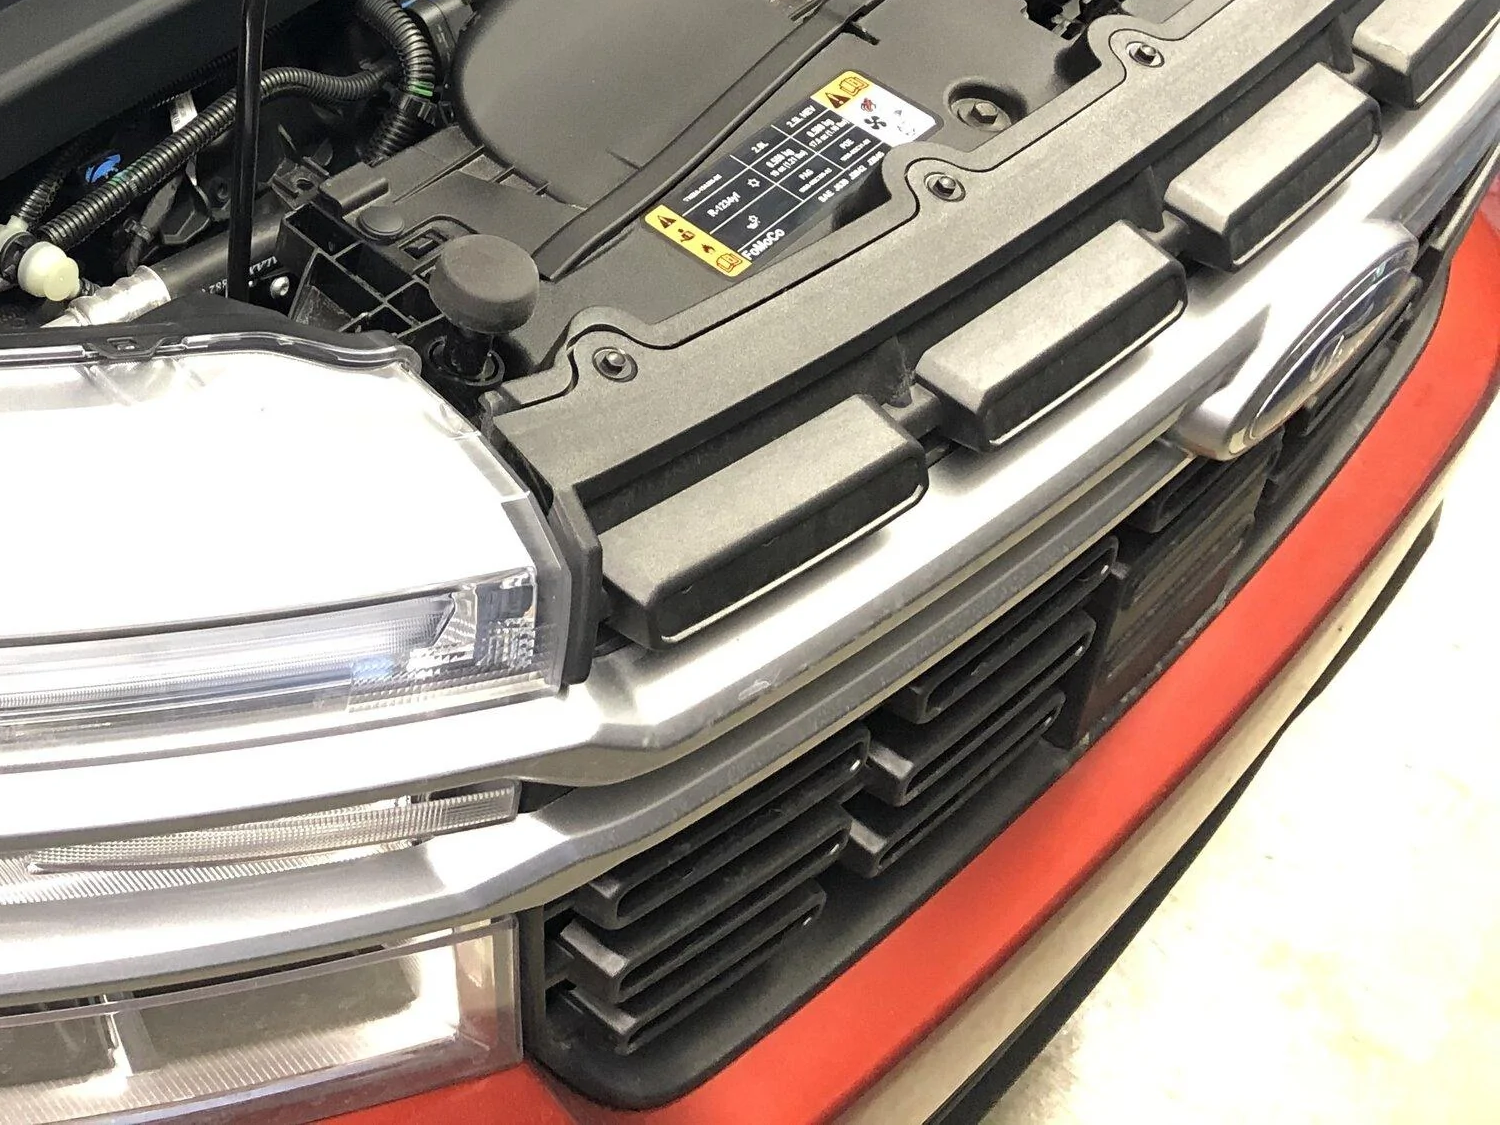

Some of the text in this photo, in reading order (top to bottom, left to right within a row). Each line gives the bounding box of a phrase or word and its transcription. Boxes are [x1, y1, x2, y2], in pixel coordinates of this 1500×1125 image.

[839, 138, 854, 150] POE
[799, 169, 814, 180] PAG
[706, 191, 741, 217] R-1234yf
[741, 228, 785, 261] FoMoCo
